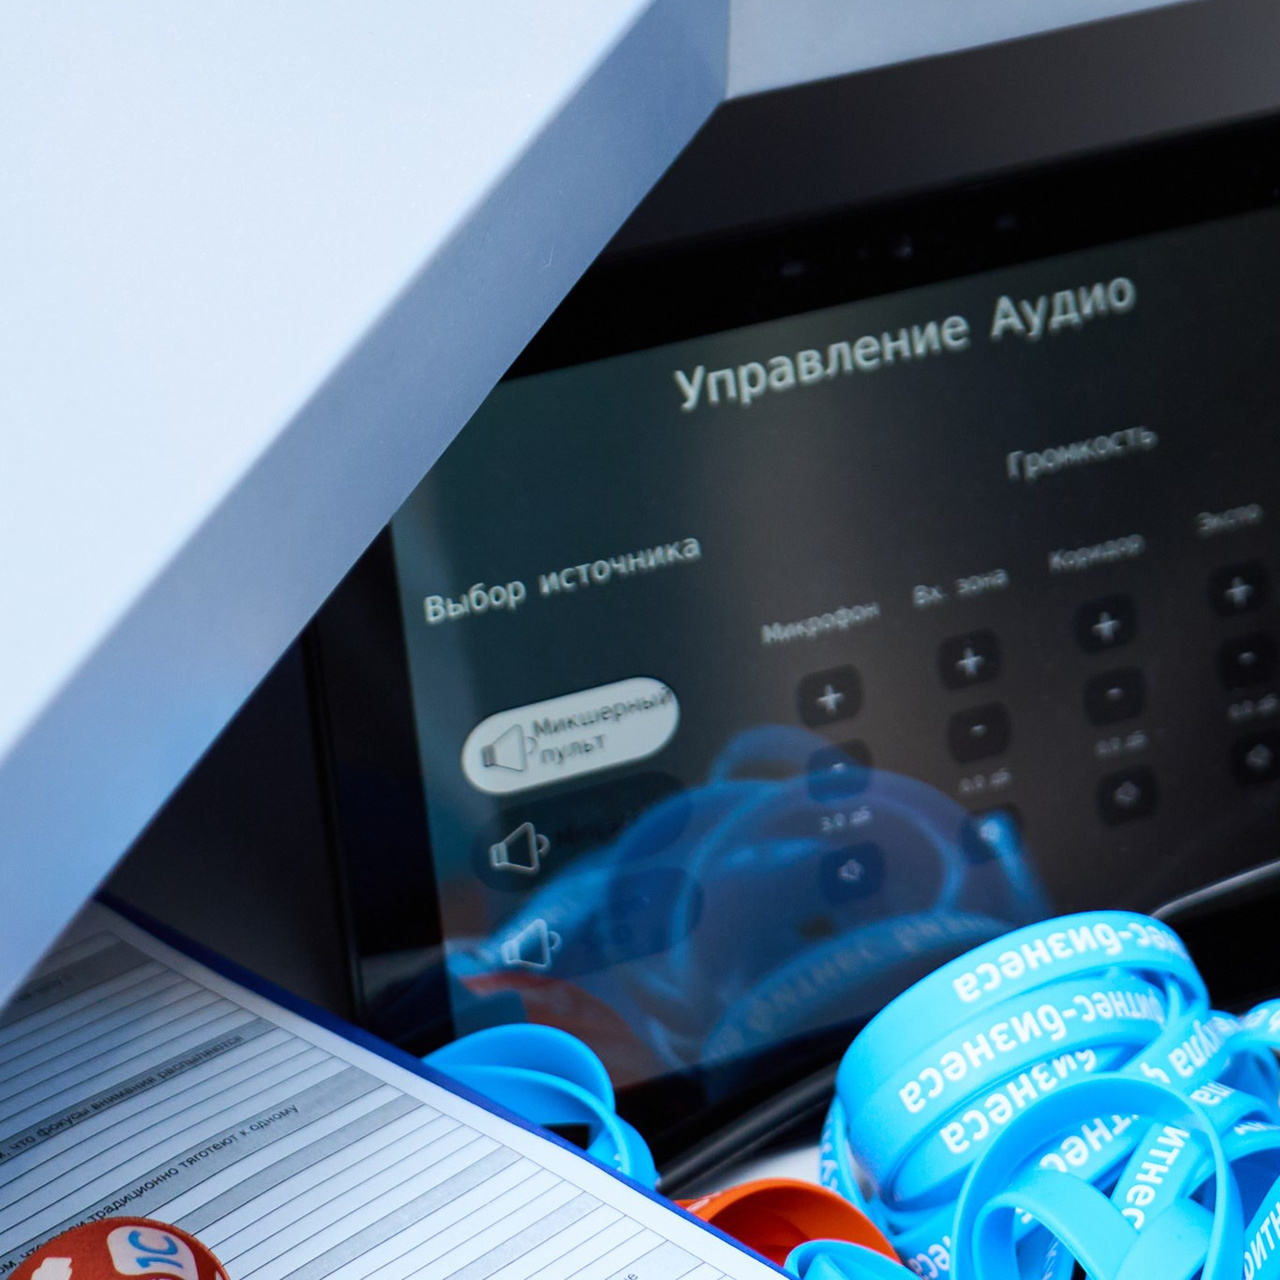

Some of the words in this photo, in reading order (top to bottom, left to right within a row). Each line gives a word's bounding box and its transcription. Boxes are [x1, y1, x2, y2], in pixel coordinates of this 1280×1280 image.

[674, 314, 970, 412] Управление
[991, 275, 1137, 342] Аудио
[1007, 424, 1158, 482] Громкость
[424, 579, 525, 624] Выбор
[538, 535, 701, 596] источника
[761, 601, 880, 645] Микрофон
[532, 686, 675, 740] Микшерный
[540, 734, 606, 768] пульт
[37, 1107, 90, 1139] фокусы
[92, 1077, 156, 1111] внимания
[158, 1035, 244, 1080] распыляются
[89, 1166, 179, 1223] традиционно
[178, 1134, 239, 1169] тяготеют
[240, 1127, 249, 1137] к
[250, 1103, 299, 1132] одному
